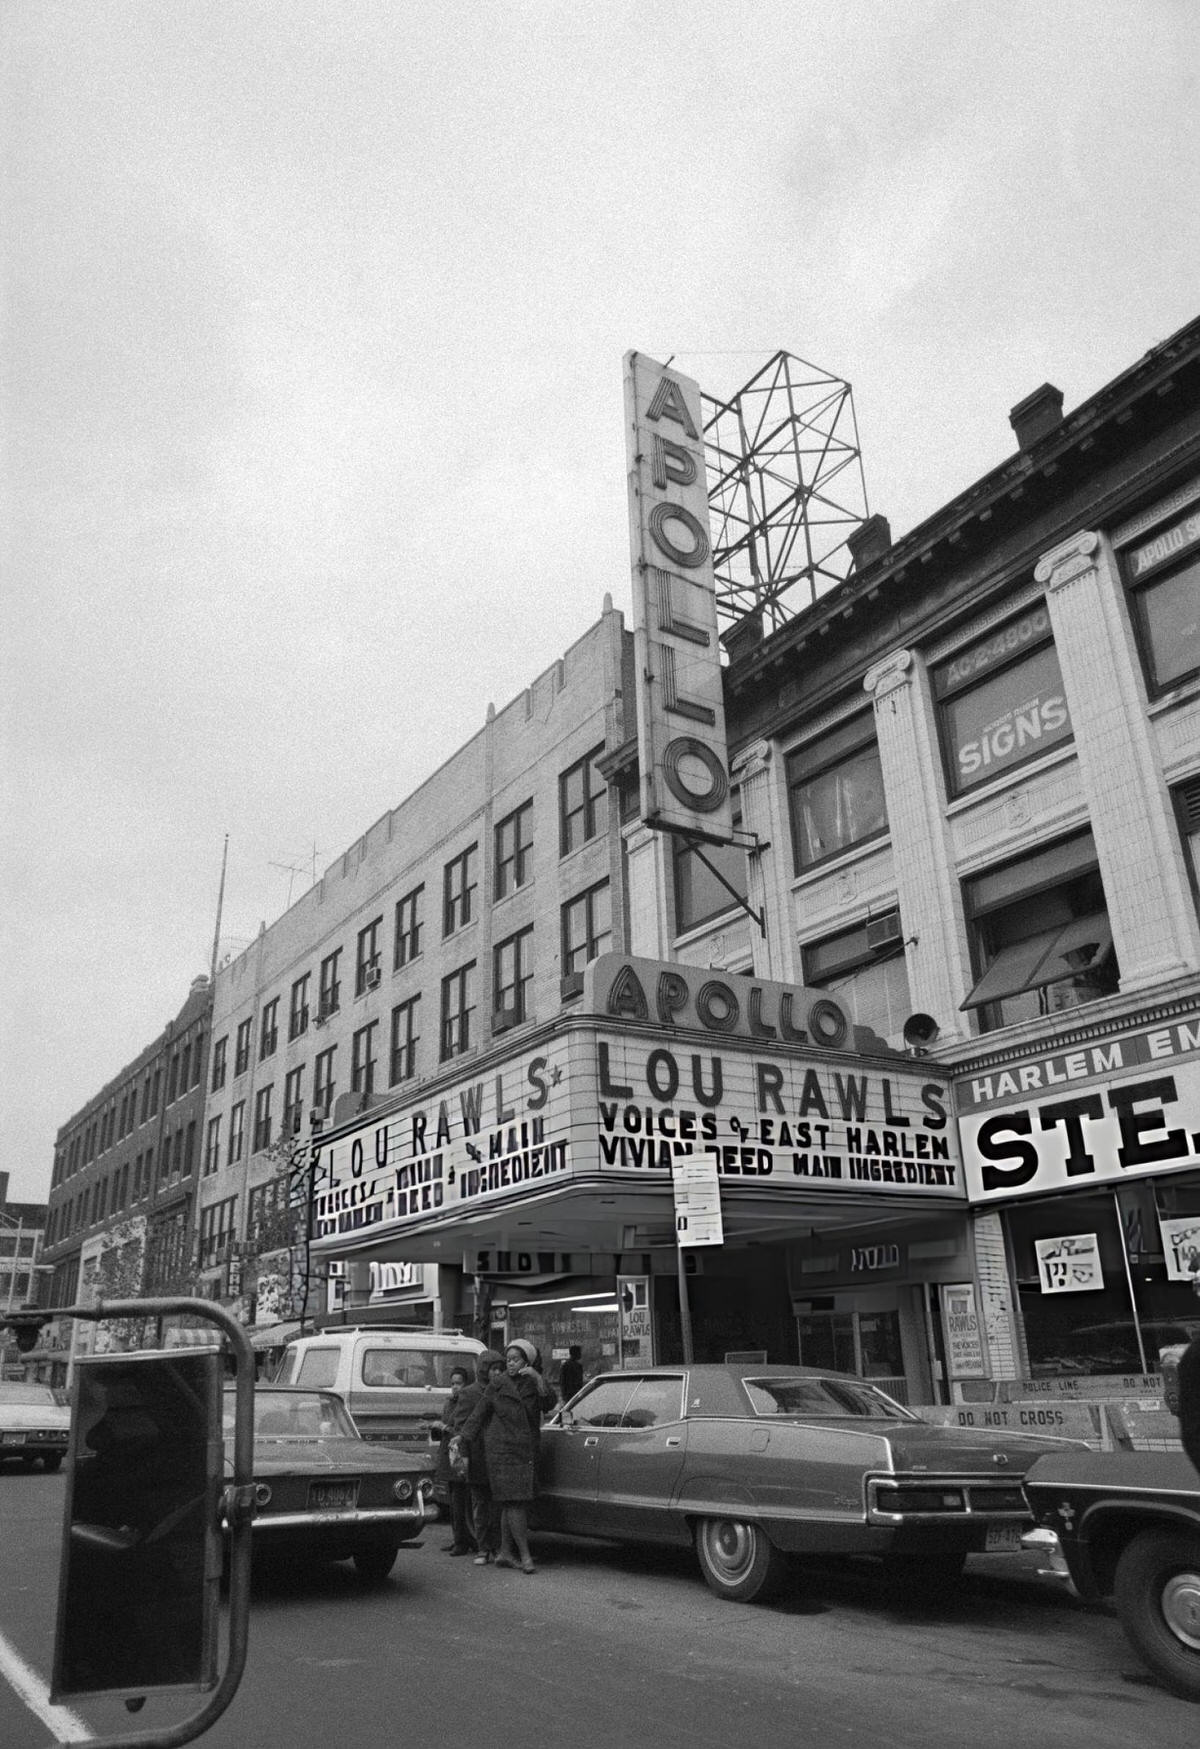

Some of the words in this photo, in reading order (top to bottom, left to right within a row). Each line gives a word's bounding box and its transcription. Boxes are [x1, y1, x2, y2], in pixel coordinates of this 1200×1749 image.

[1134, 527, 1183, 577] APOLLO
[645, 376, 729, 814] APOLLO
[958, 696, 1067, 774] SIGNS
[606, 964, 848, 1048] APOLLO
[598, 1041, 724, 1108] LOU
[757, 1062, 947, 1130] RAWLS
[971, 1042, 1124, 1103] HARLEM
[329, 1125, 388, 1190] LOU
[412, 1056, 549, 1157] RAWLS
[599, 1102, 718, 1140] VOICES
[760, 1118, 830, 1151] EAST
[846, 1126, 950, 1161] HARLEM
[976, 1075, 1200, 1191] STE
[849, 1156, 956, 1187] INGREDIENT
[1142, 1377, 1161, 1388] NOT
[958, 1411, 975, 1426] DO
[984, 1411, 1008, 1426] NOT
[1020, 1410, 1064, 1426] CROSS
